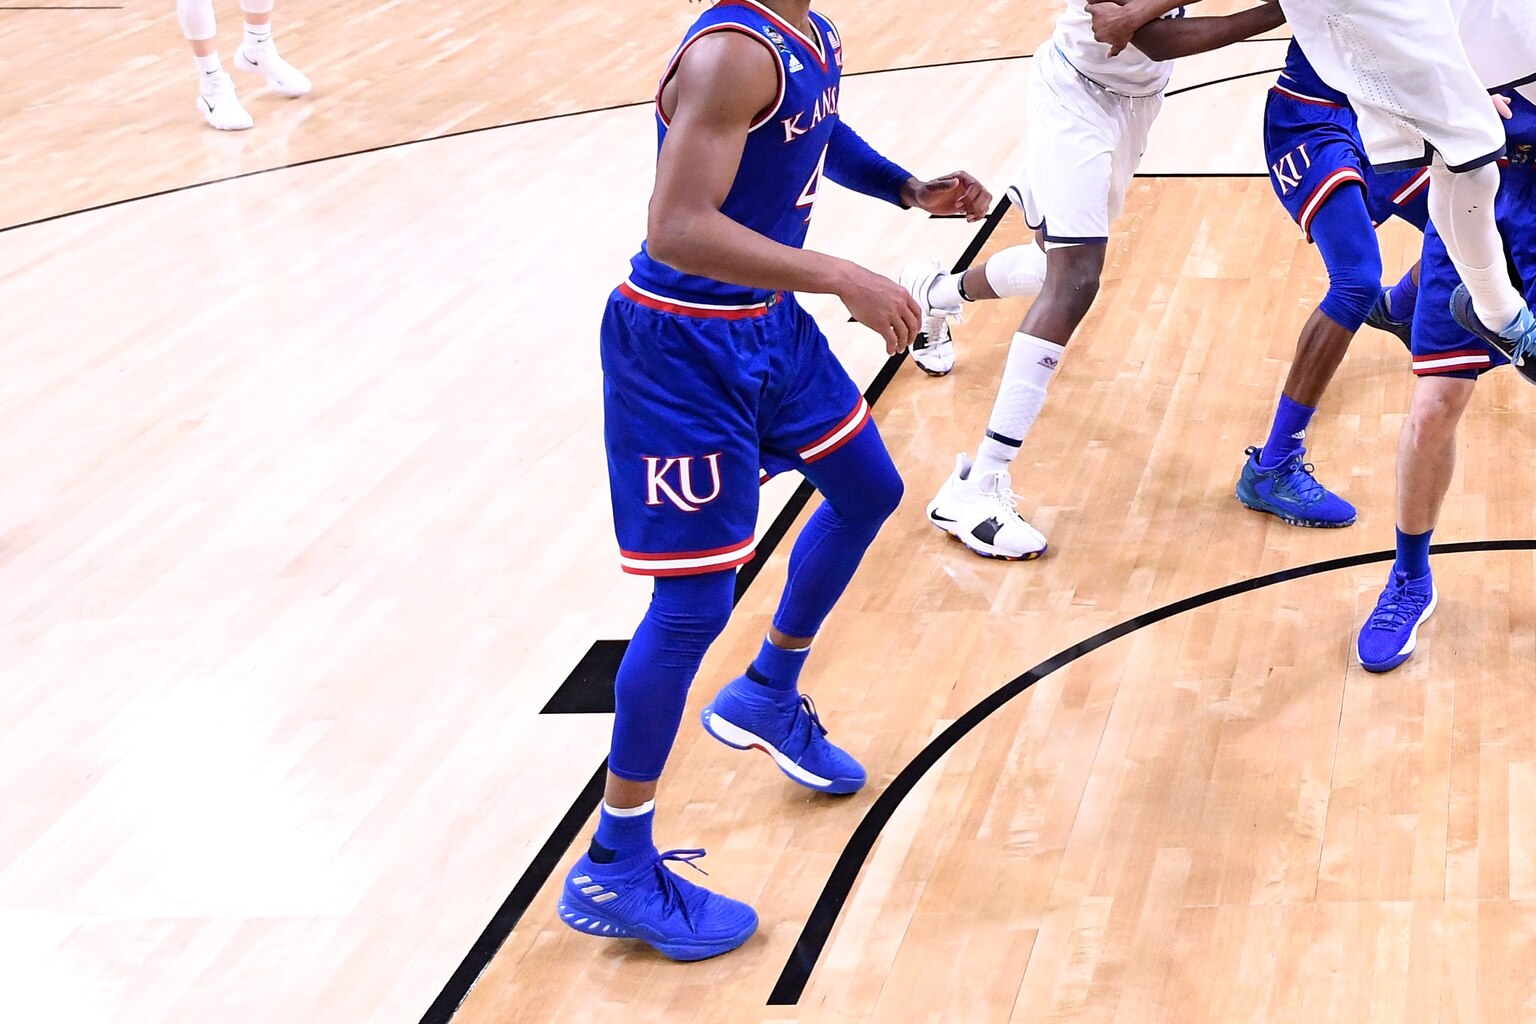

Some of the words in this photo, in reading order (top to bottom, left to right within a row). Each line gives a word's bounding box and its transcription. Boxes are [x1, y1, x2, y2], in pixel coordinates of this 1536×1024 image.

[795, 141, 830, 225] 4
[1271, 142, 1312, 197] KU
[642, 451, 723, 513] KU
